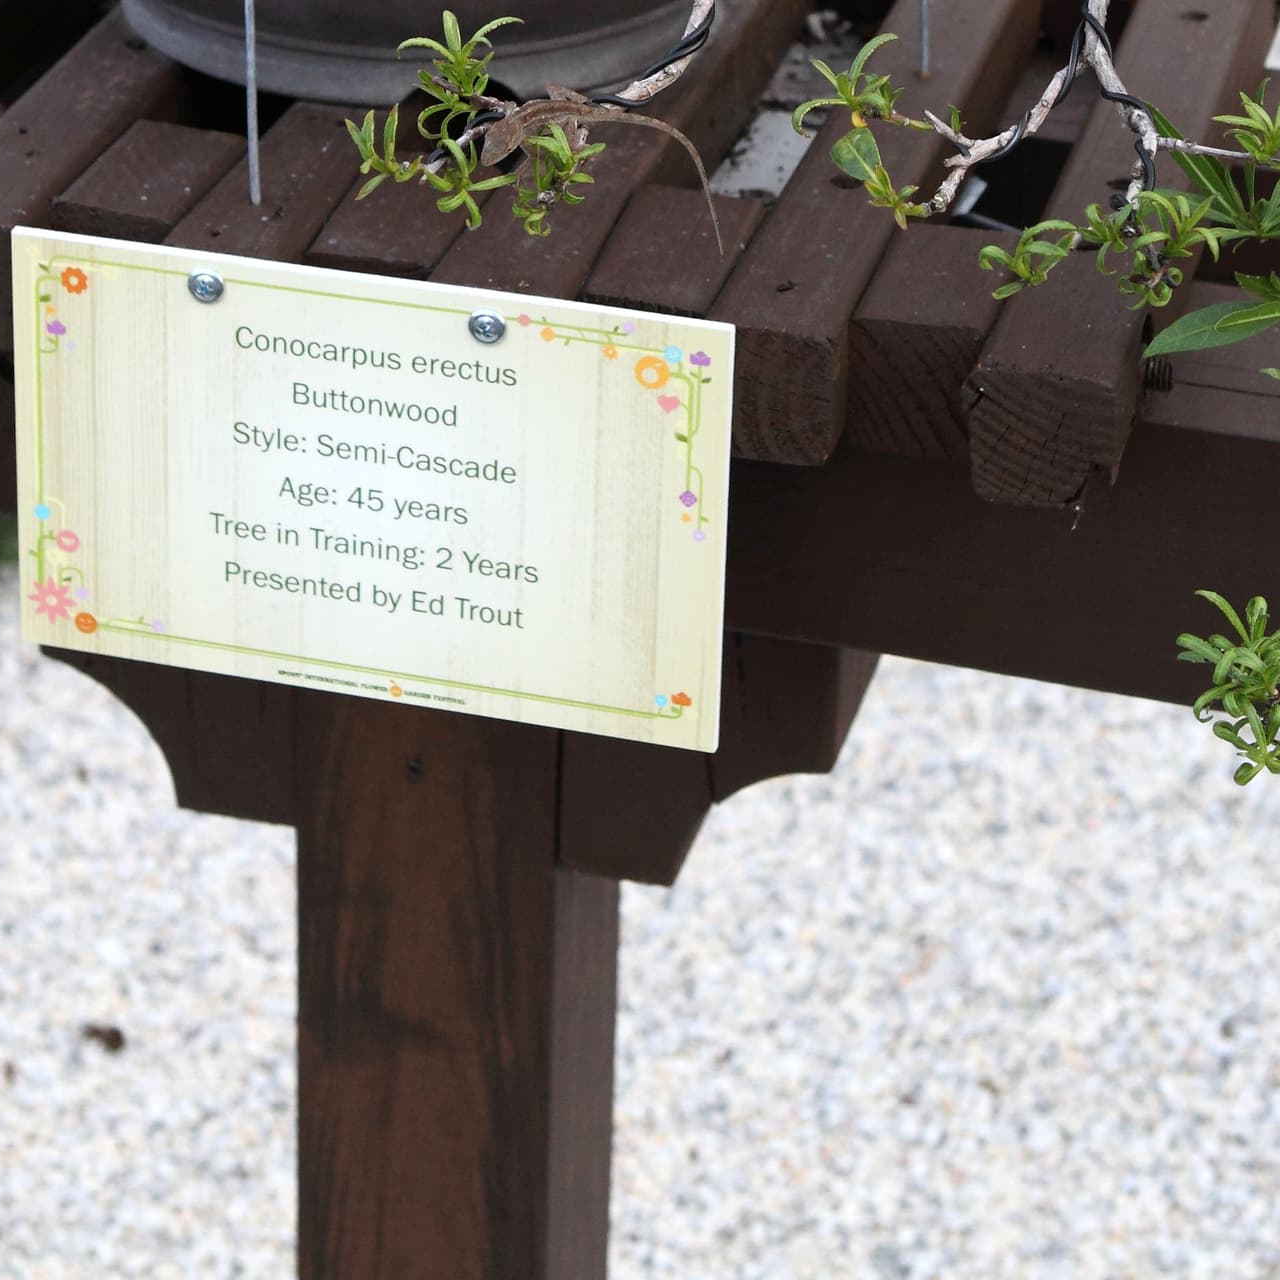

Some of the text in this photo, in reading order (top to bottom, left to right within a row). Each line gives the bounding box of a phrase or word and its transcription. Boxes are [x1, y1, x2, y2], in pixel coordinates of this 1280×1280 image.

[234, 325, 518, 387] Conocarpus erectus
[292, 381, 458, 427] Buttonwood
[232, 421, 517, 485] Style: Semi-Cascade
[278, 476, 469, 525] Age: 45 years
[209, 511, 539, 584] Tree in Training: 2 Years
[224, 560, 525, 630] Presented by Ed Trout
